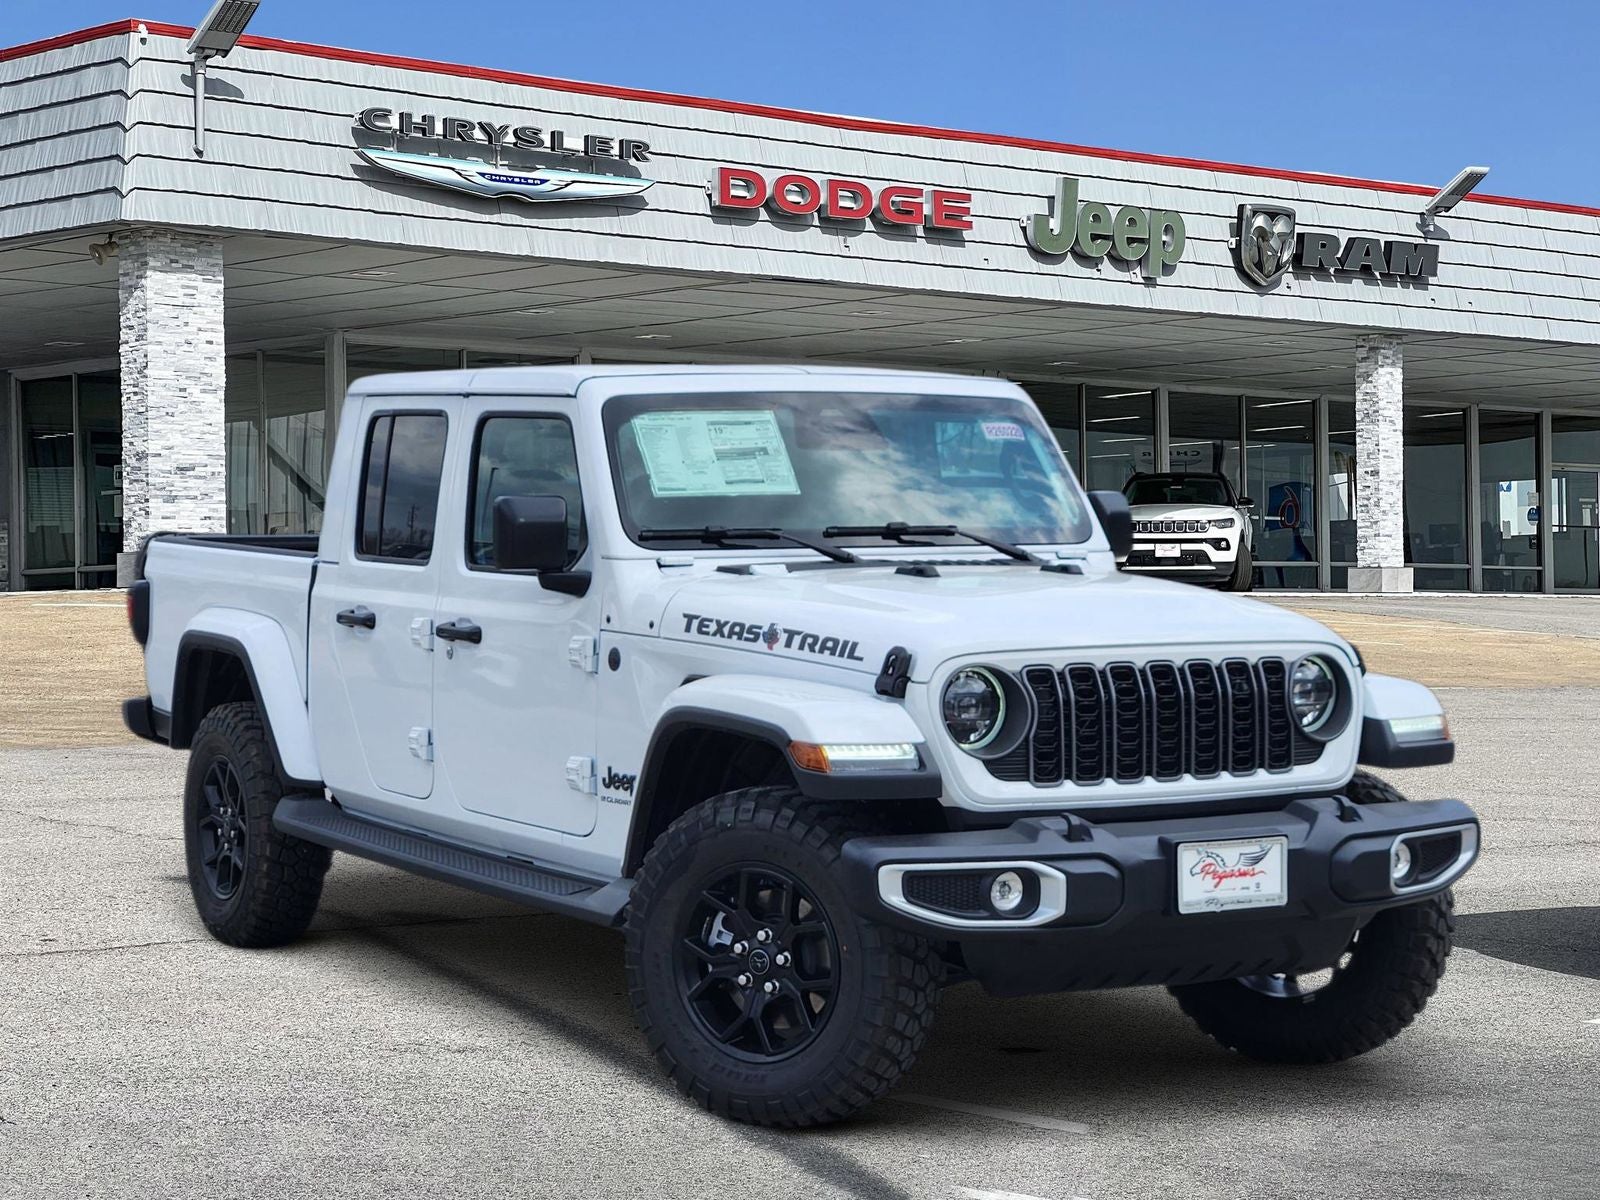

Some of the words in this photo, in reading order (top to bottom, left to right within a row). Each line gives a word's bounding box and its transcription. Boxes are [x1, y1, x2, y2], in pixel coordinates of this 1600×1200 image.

[357, 106, 651, 162] CHRYSLER
[484, 174, 541, 184] CHRYSLER
[712, 166, 974, 231] DODGE
[1026, 176, 1186, 279] Jeep
[1296, 231, 1440, 278] RAM
[682, 613, 763, 643] TEXAS
[783, 628, 865, 662] TRAIL
